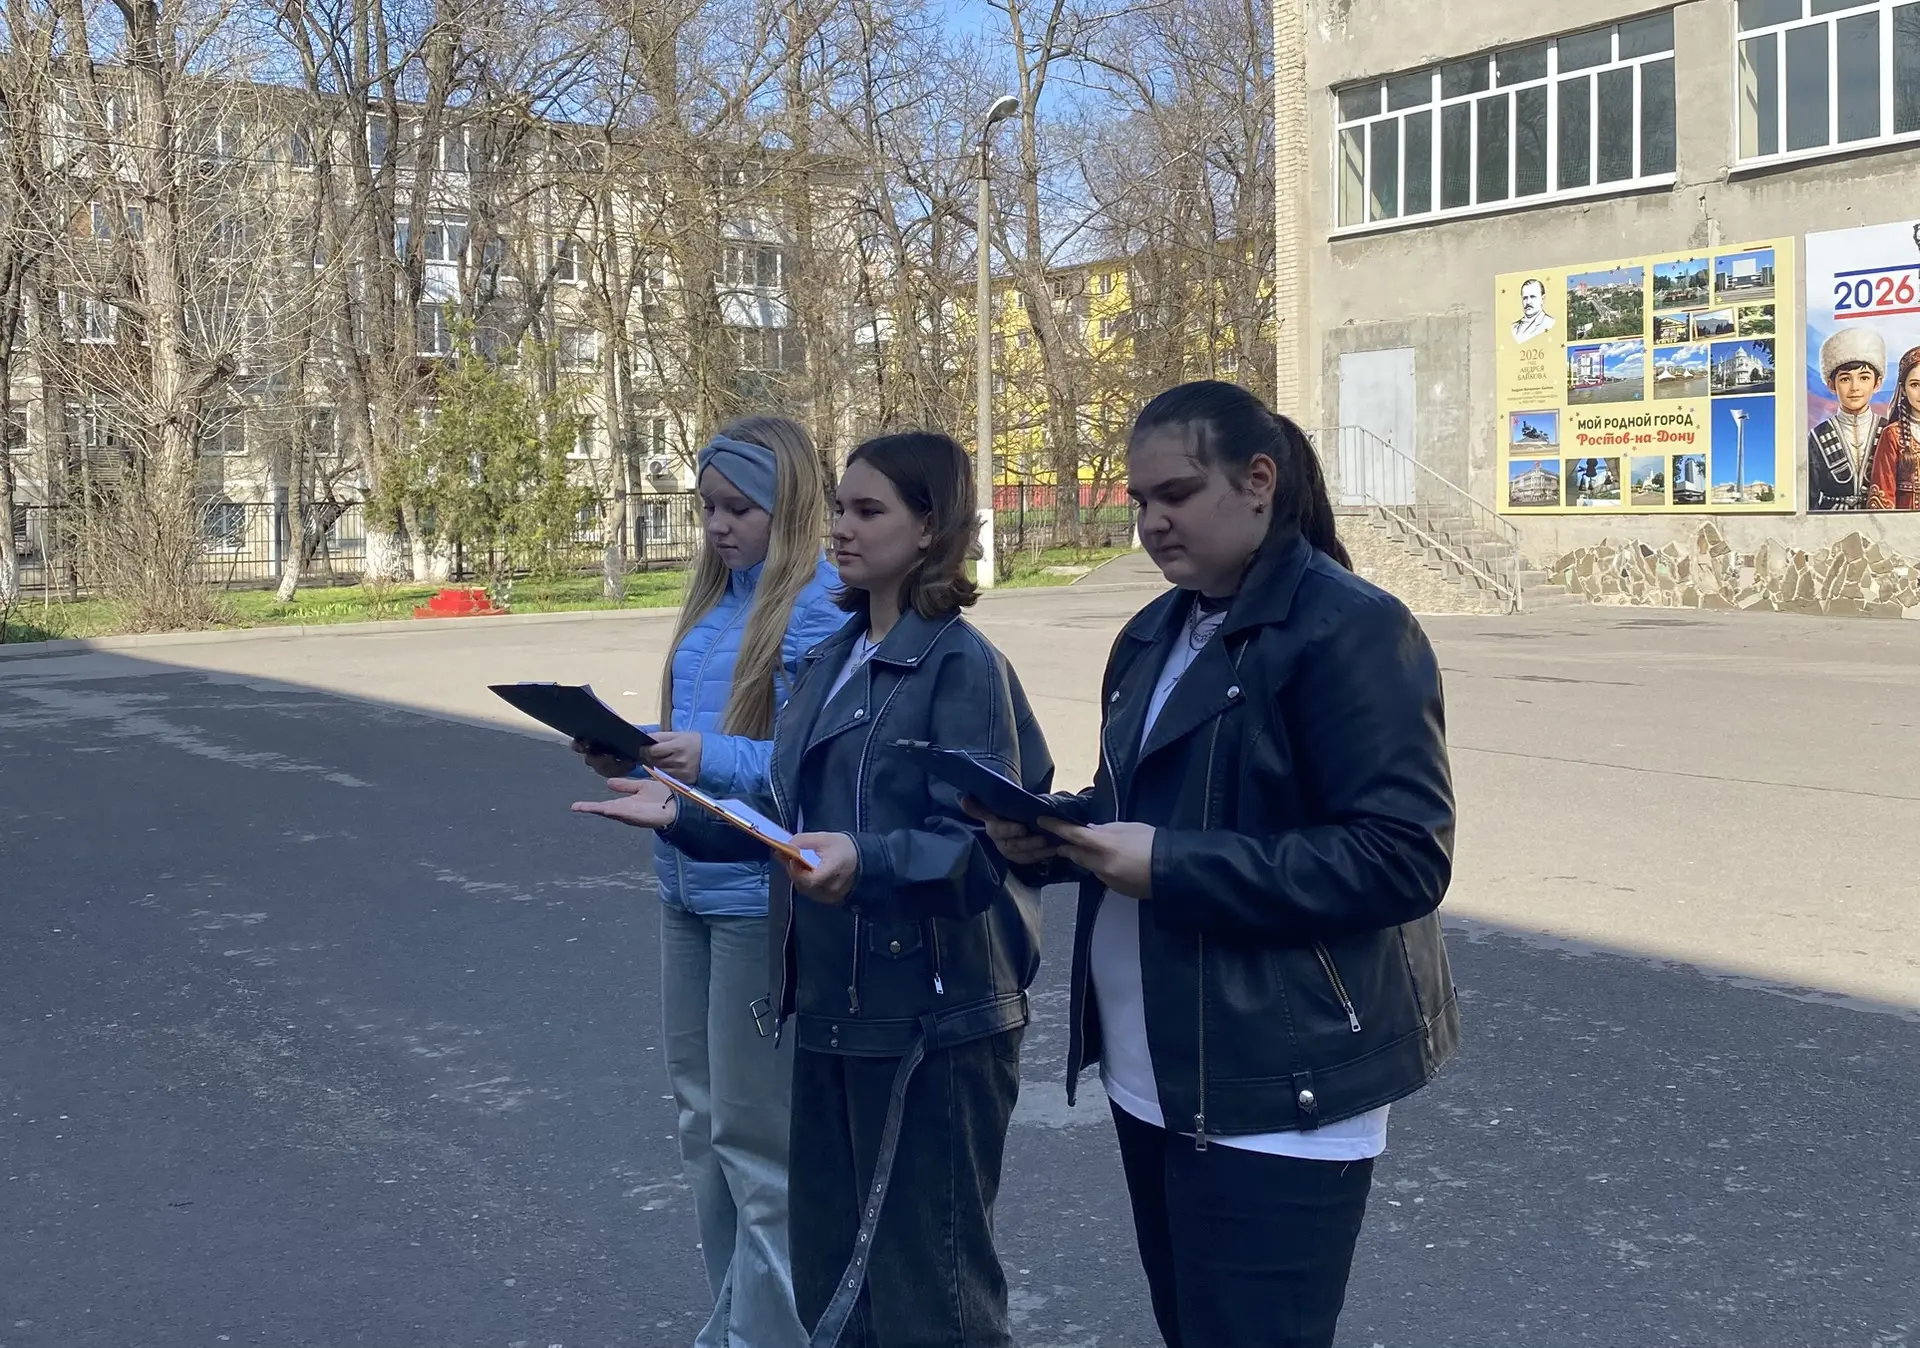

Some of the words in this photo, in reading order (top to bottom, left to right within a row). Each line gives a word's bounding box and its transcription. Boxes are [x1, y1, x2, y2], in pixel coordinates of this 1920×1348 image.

[1834, 275, 1915, 310] 2026
[1520, 348, 1545, 361] 2026
[1578, 416, 1602, 430] МОЙ
[1604, 413, 1652, 430] РОДНОЙ
[1654, 414, 1694, 426] ГОРОД
[1576, 430, 1696, 446] Ростов-на-Дону
